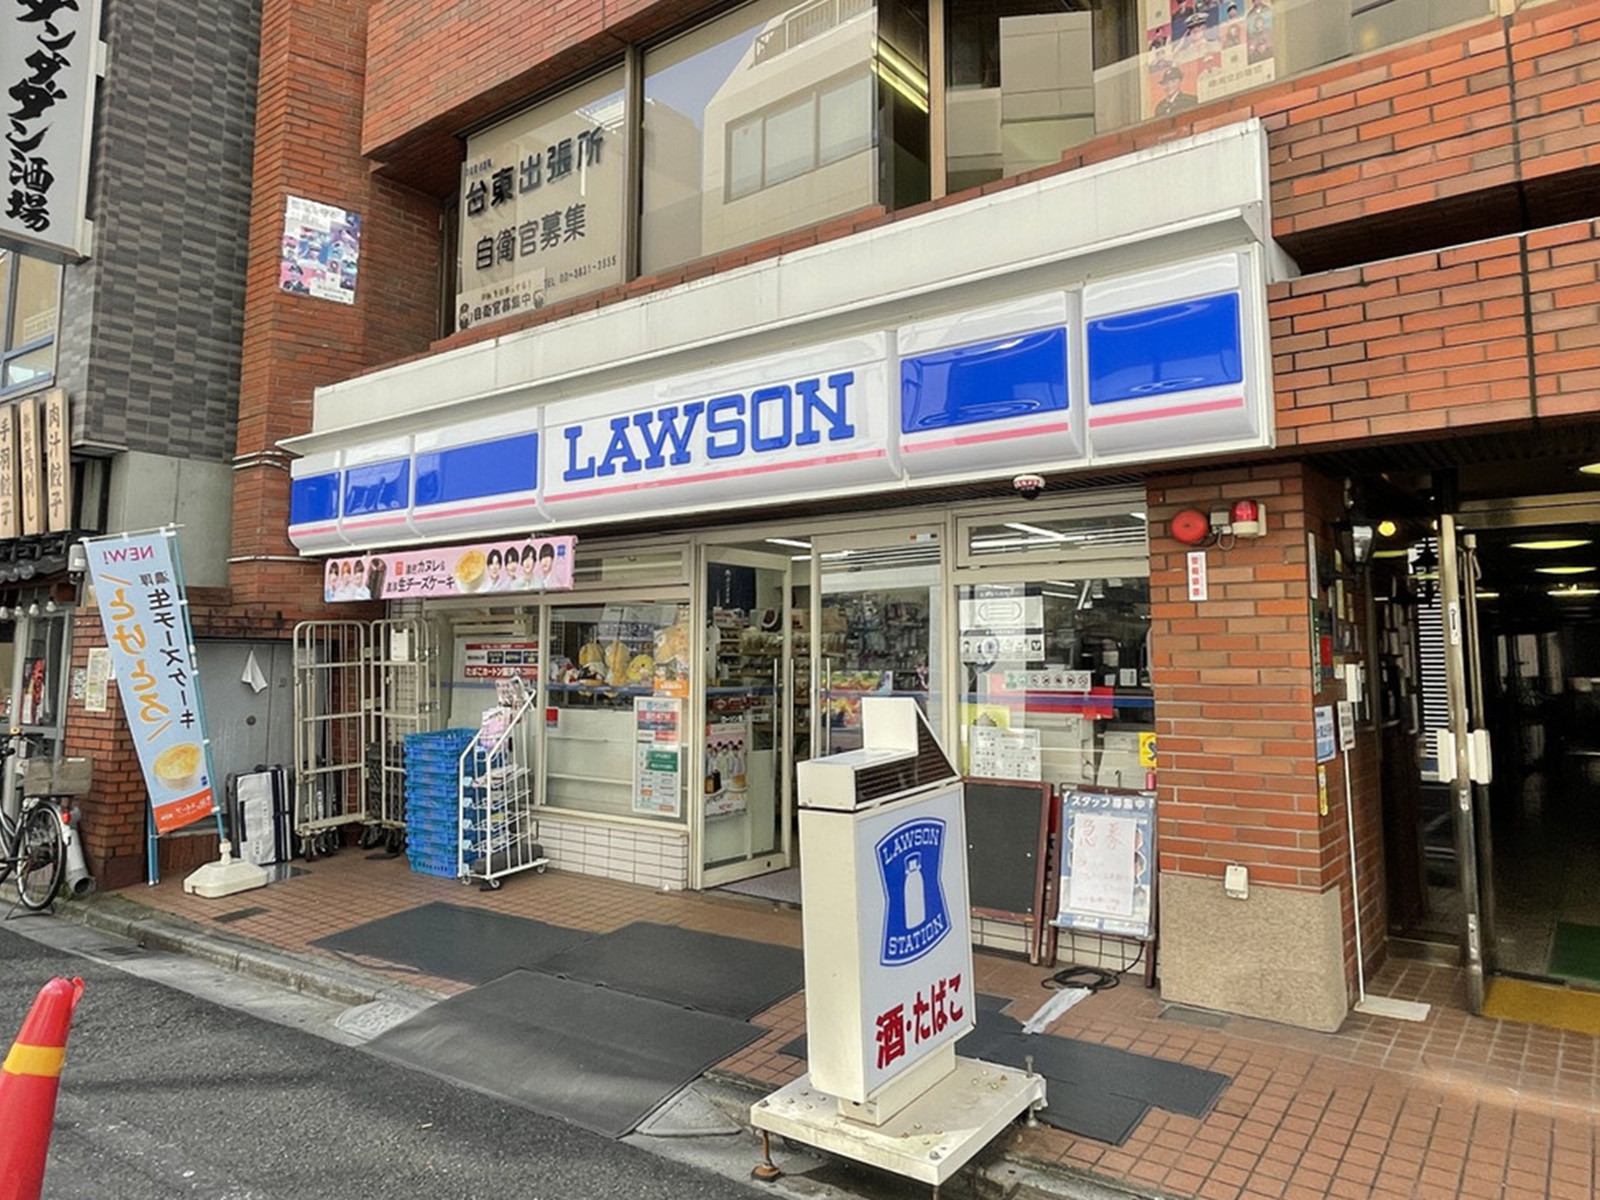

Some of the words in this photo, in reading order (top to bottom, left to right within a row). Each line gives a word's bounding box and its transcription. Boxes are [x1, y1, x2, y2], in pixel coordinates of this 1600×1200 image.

[466, 127, 604, 217] 台東出張所
[476, 203, 587, 270] 自衛官募集
[563, 371, 855, 482] LAWSON
[881, 827, 940, 866] LAWSON
[888, 913, 944, 957] STATION
[875, 973, 964, 1071] 酒・たばこ
